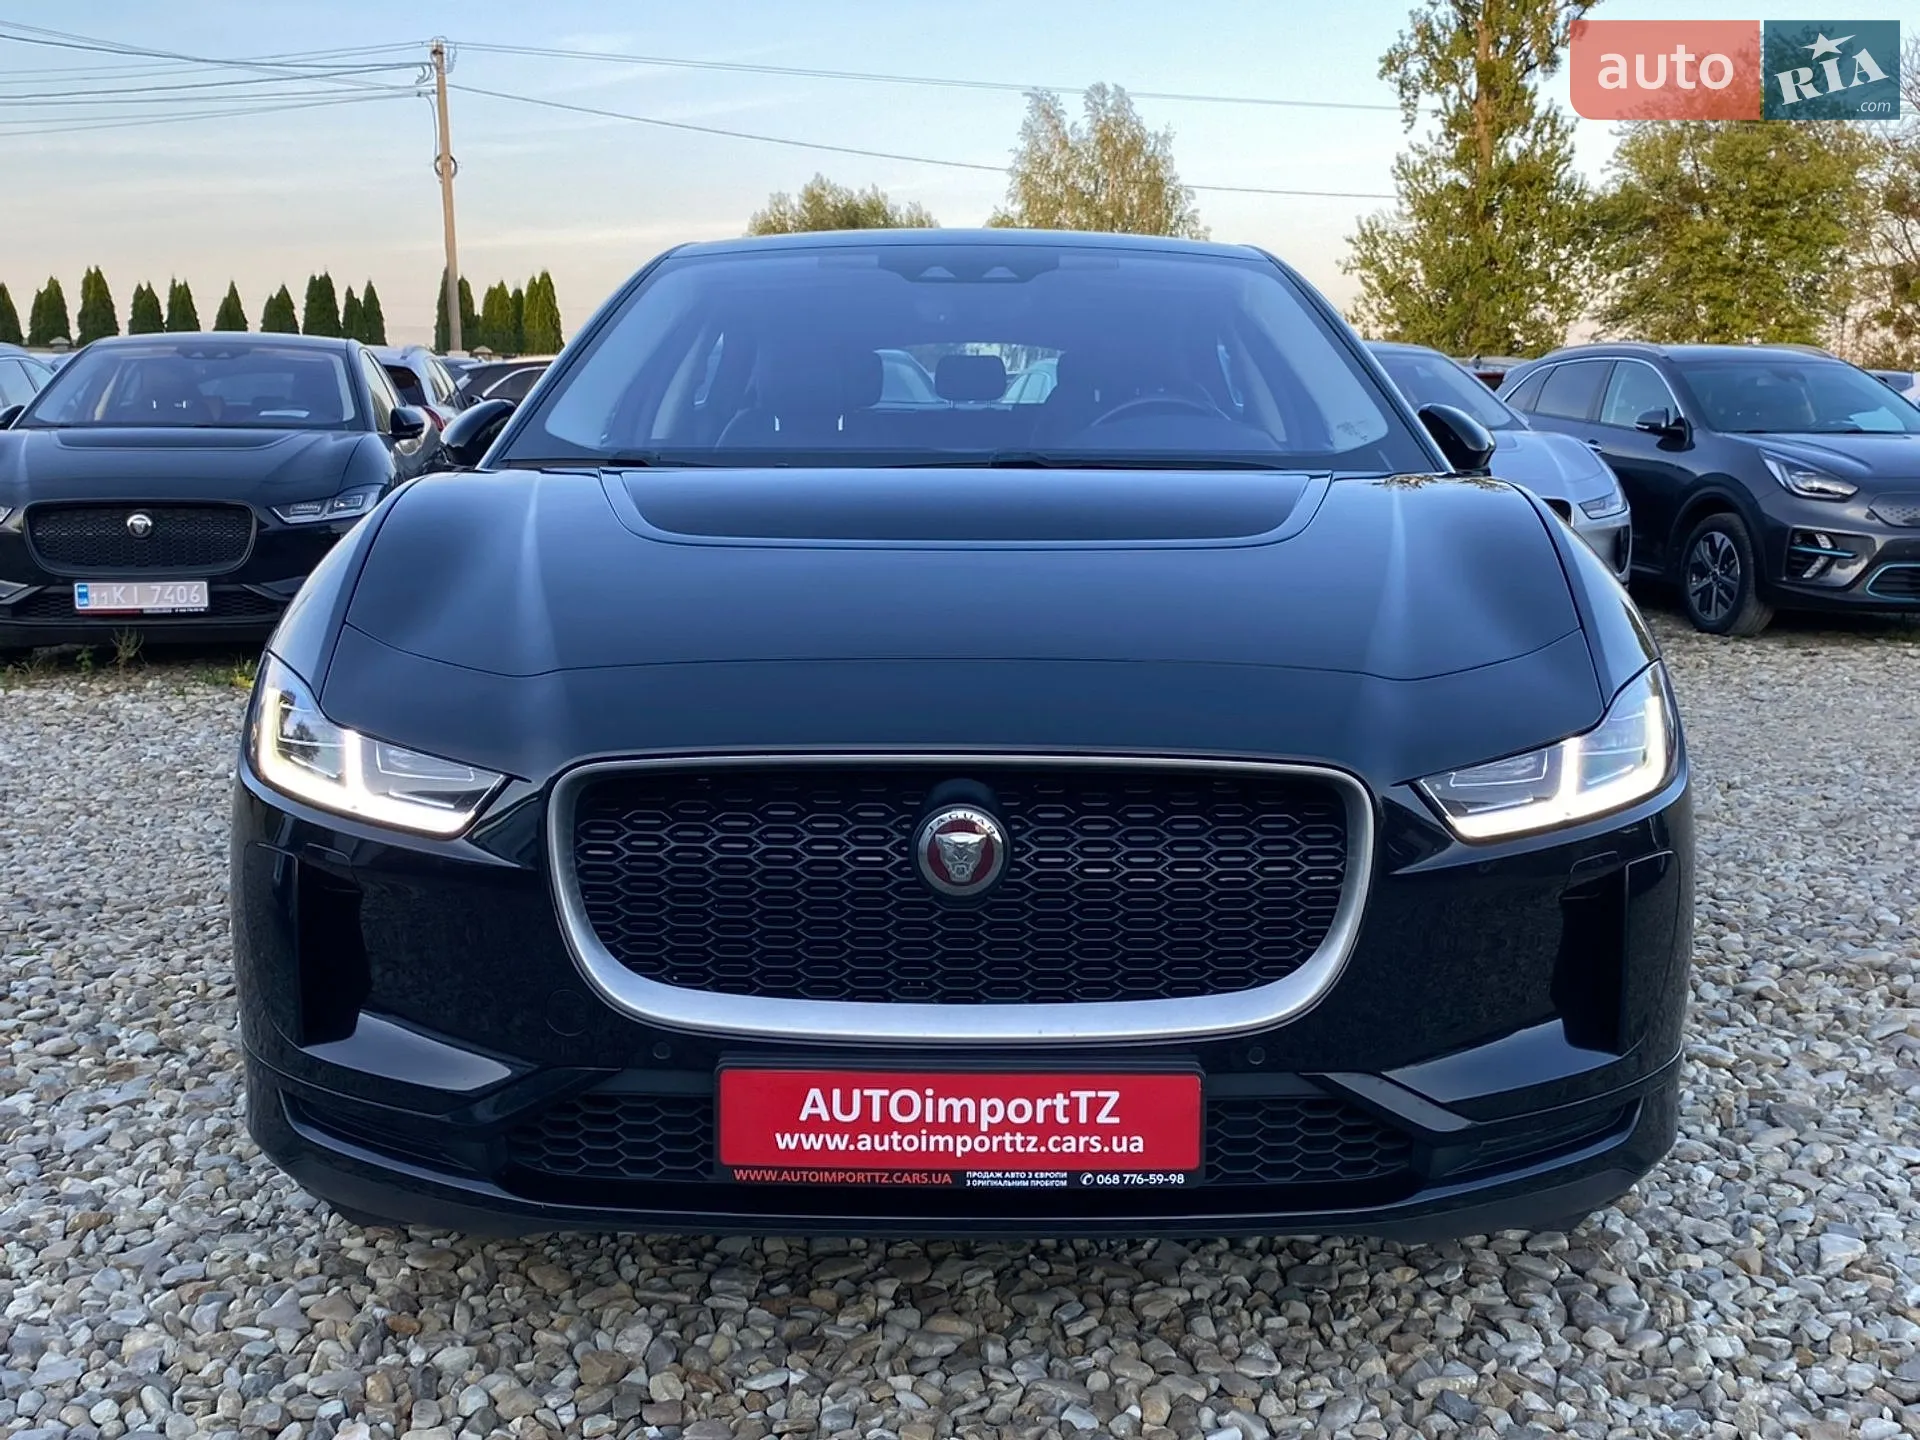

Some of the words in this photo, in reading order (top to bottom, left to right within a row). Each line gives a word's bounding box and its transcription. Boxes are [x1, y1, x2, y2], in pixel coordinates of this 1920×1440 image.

[150, 585, 201, 604] 7406
[799, 1087, 1121, 1131] AUTOimportTZ
[775, 1129, 1145, 1158] www.autoimporttz.cars.ua
[733, 1168, 953, 1185] WWW.AUTOIMPORTTZ.CARS.UA
[966, 1171, 1003, 1180] ПРОДАЖ
[1004, 1171, 1026, 1179] АВТО
[1096, 1173, 1120, 1185] 068
[1123, 1173, 1185, 1185] 776-59-98
